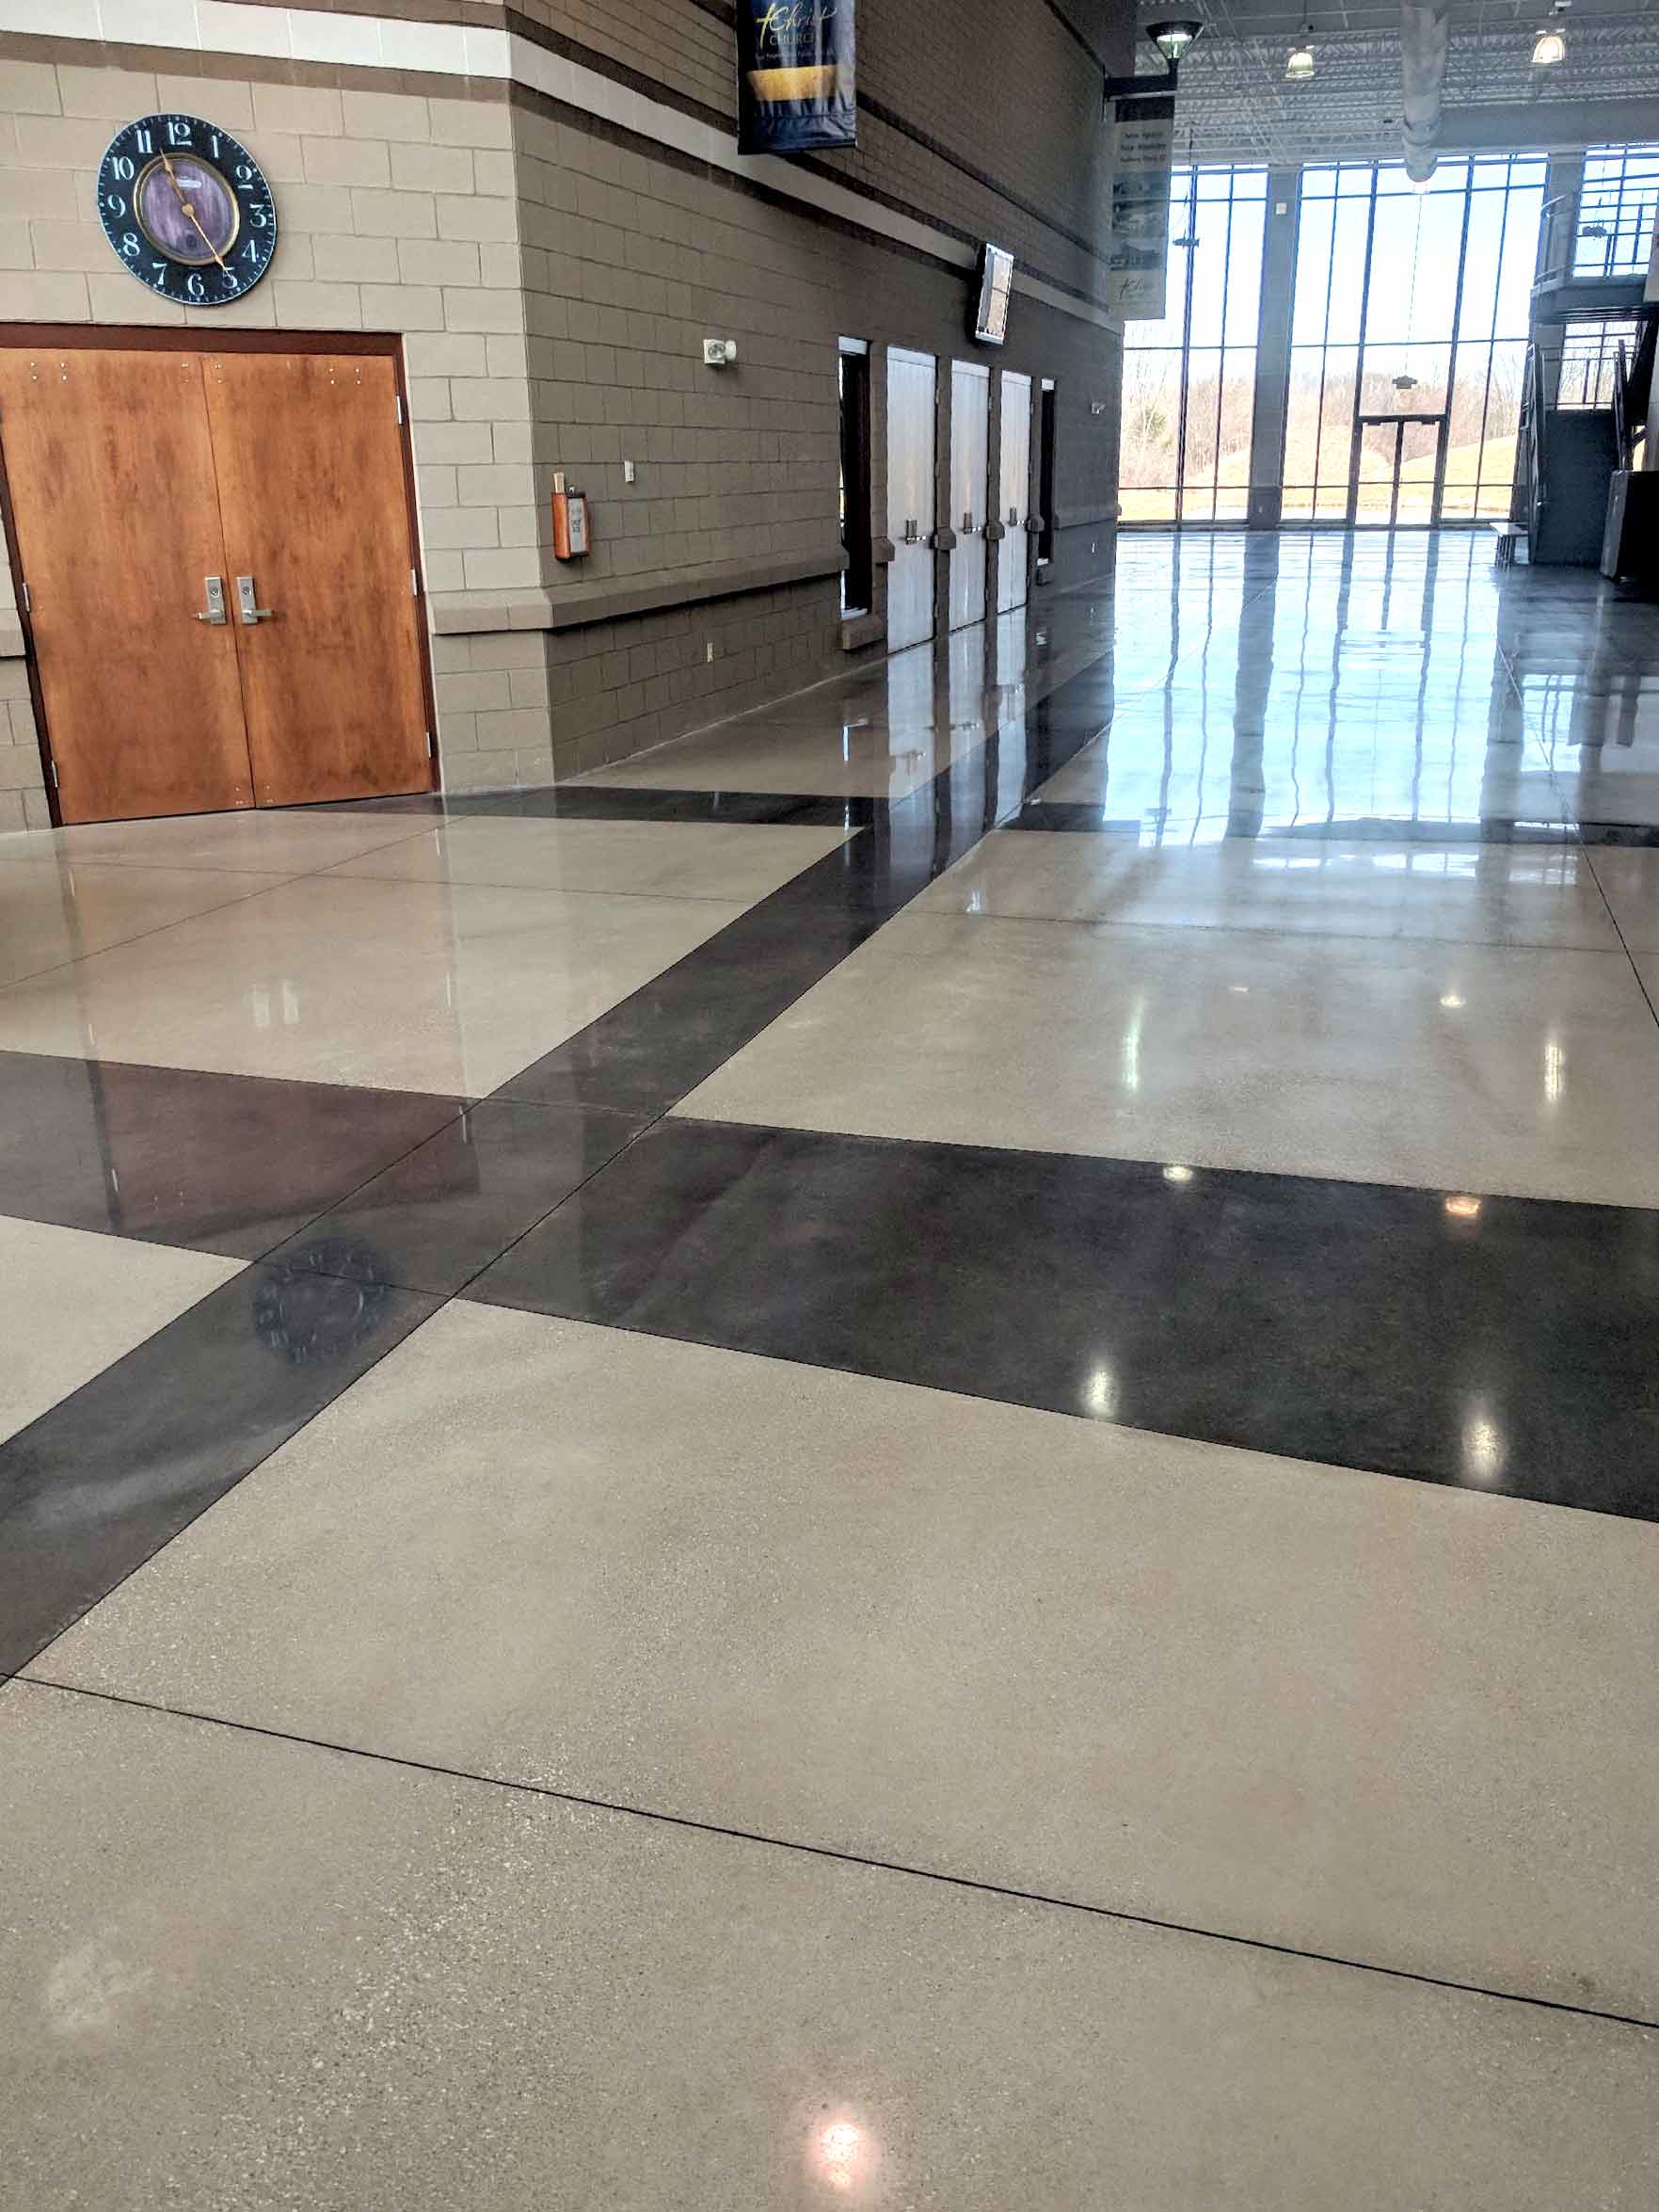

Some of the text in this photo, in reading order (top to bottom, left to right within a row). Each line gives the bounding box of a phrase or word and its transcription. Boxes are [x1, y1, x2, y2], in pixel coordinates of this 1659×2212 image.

[136, 130, 153, 153] 11
[167, 121, 193, 146] 12
[211, 135, 219, 158] 1
[112, 156, 135, 180] 10
[236, 165, 254, 189] 2
[107, 195, 126, 218] 9
[248, 203, 267, 227] 3
[122, 232, 140, 256] 8
[241, 239, 259, 263] 4
[152, 262, 167, 285] 7
[187, 273, 205, 297] 6
[222, 266, 238, 289] 5
